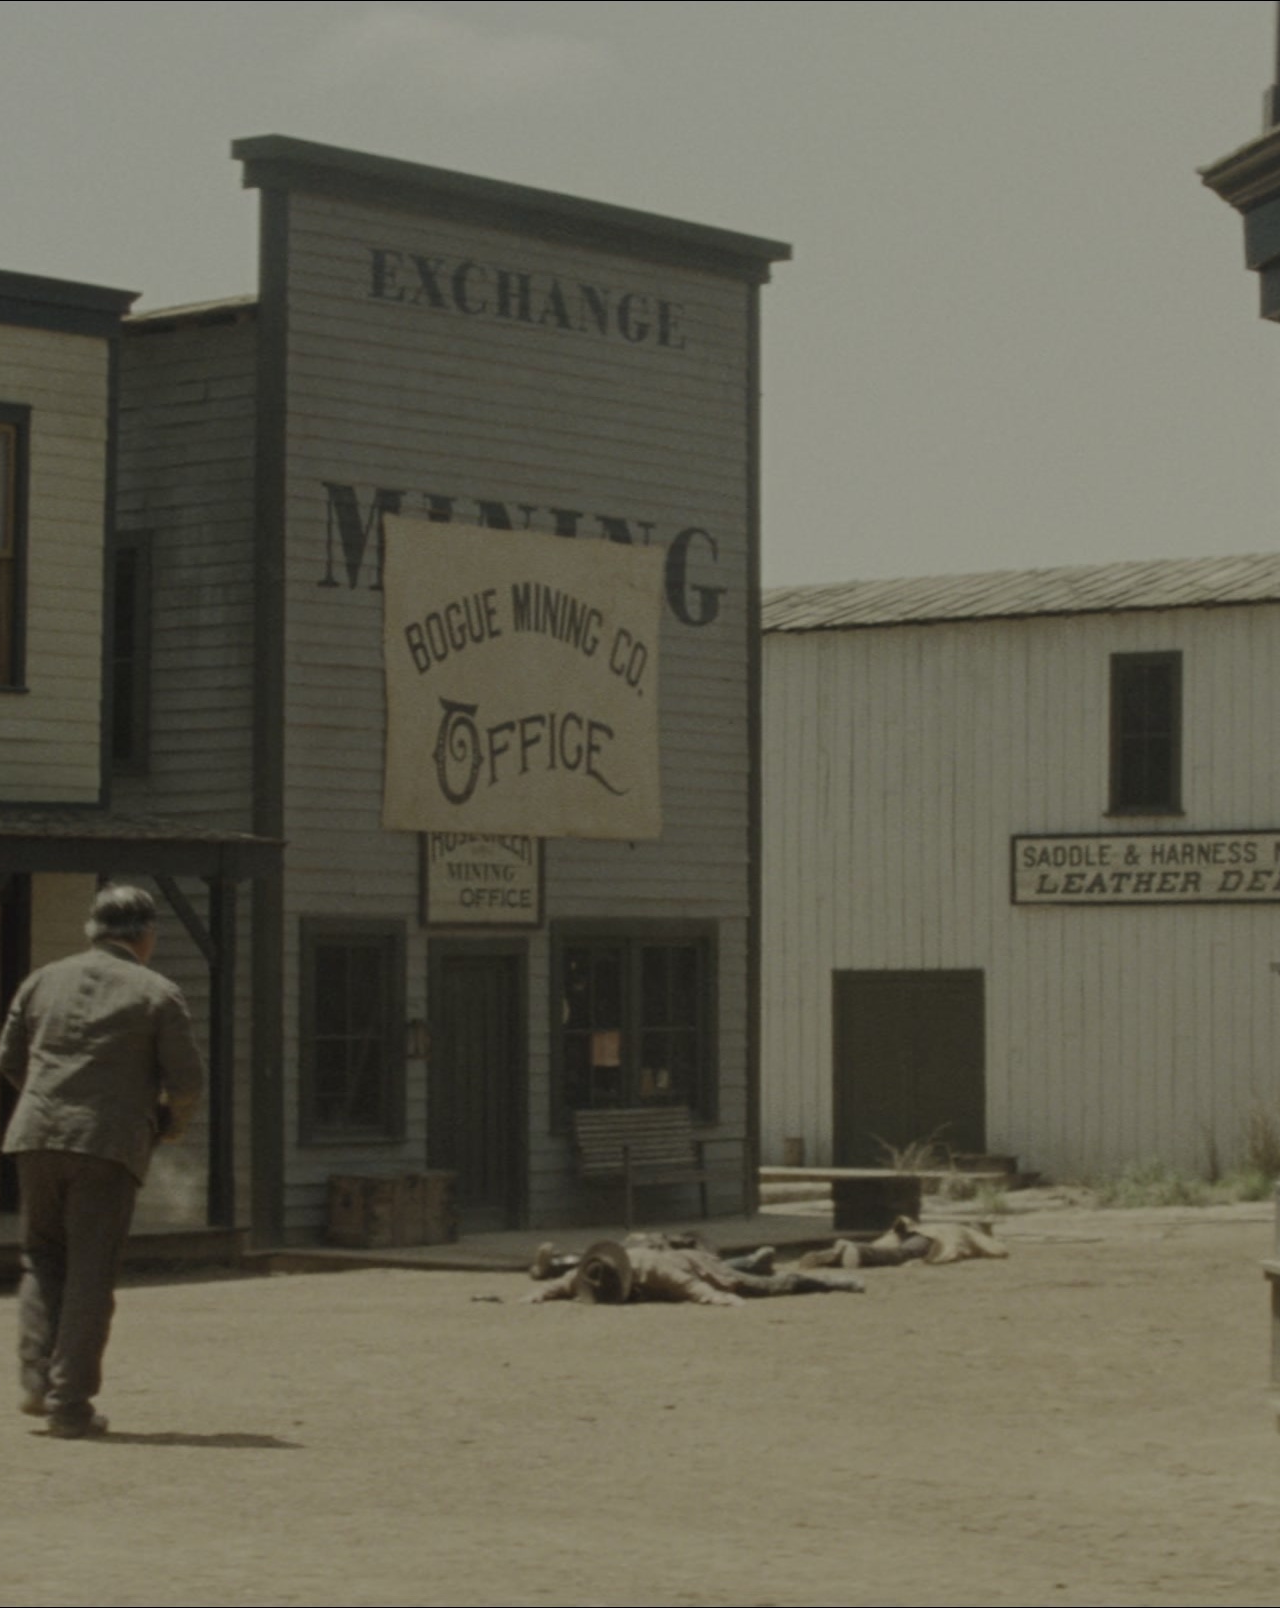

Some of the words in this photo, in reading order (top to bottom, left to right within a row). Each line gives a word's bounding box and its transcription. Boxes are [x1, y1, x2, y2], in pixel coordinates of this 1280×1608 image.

[368, 248, 687, 350] EXCHANGE
[404, 588, 502, 675] BOGUE
[512, 582, 603, 656] MINING
[609, 627, 648, 697] CO.
[432, 696, 631, 805] OFFICE
[1023, 845, 1111, 868] SADDLE
[1124, 844, 1140, 864] &
[1151, 840, 1257, 864] HARNESS
[446, 862, 516, 882] MINING
[1035, 871, 1202, 894] LEATHER
[460, 887, 532, 908] OFFICE
